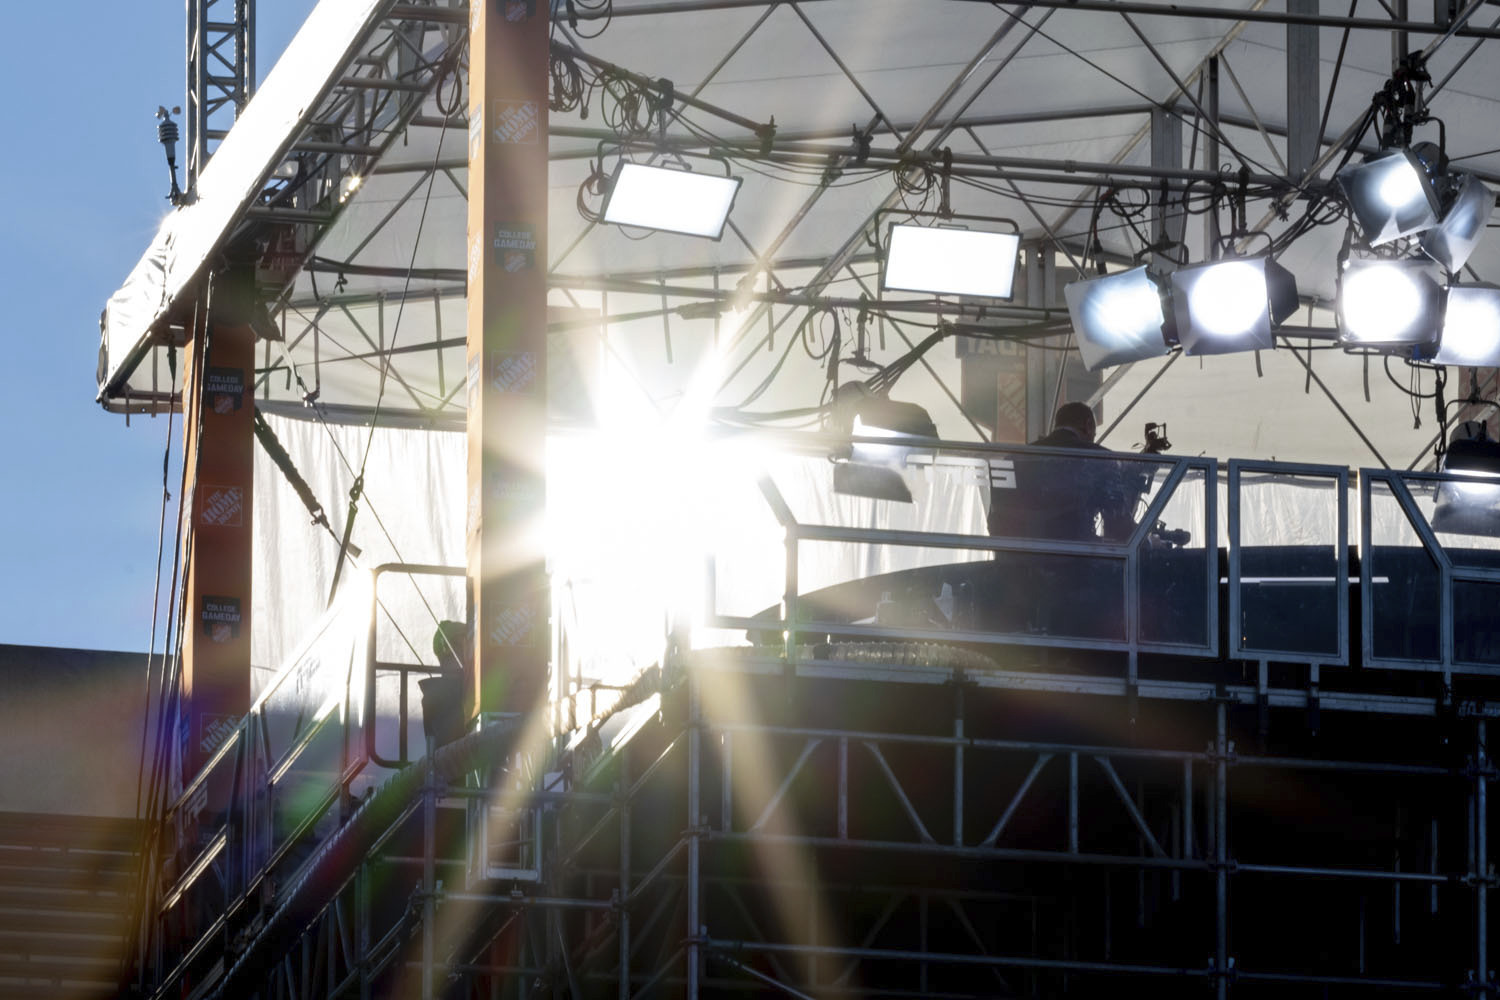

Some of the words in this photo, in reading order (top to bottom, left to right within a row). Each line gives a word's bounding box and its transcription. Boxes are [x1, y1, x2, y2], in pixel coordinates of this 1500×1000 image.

[495, 101, 536, 142] HOME
[493, 239, 536, 249] GAMEDAY
[208, 375, 239, 385] COLLEGE
[202, 487, 242, 524] HOME
[206, 603, 237, 613] COLLEGE
[201, 611, 241, 623] GAMEDAY
